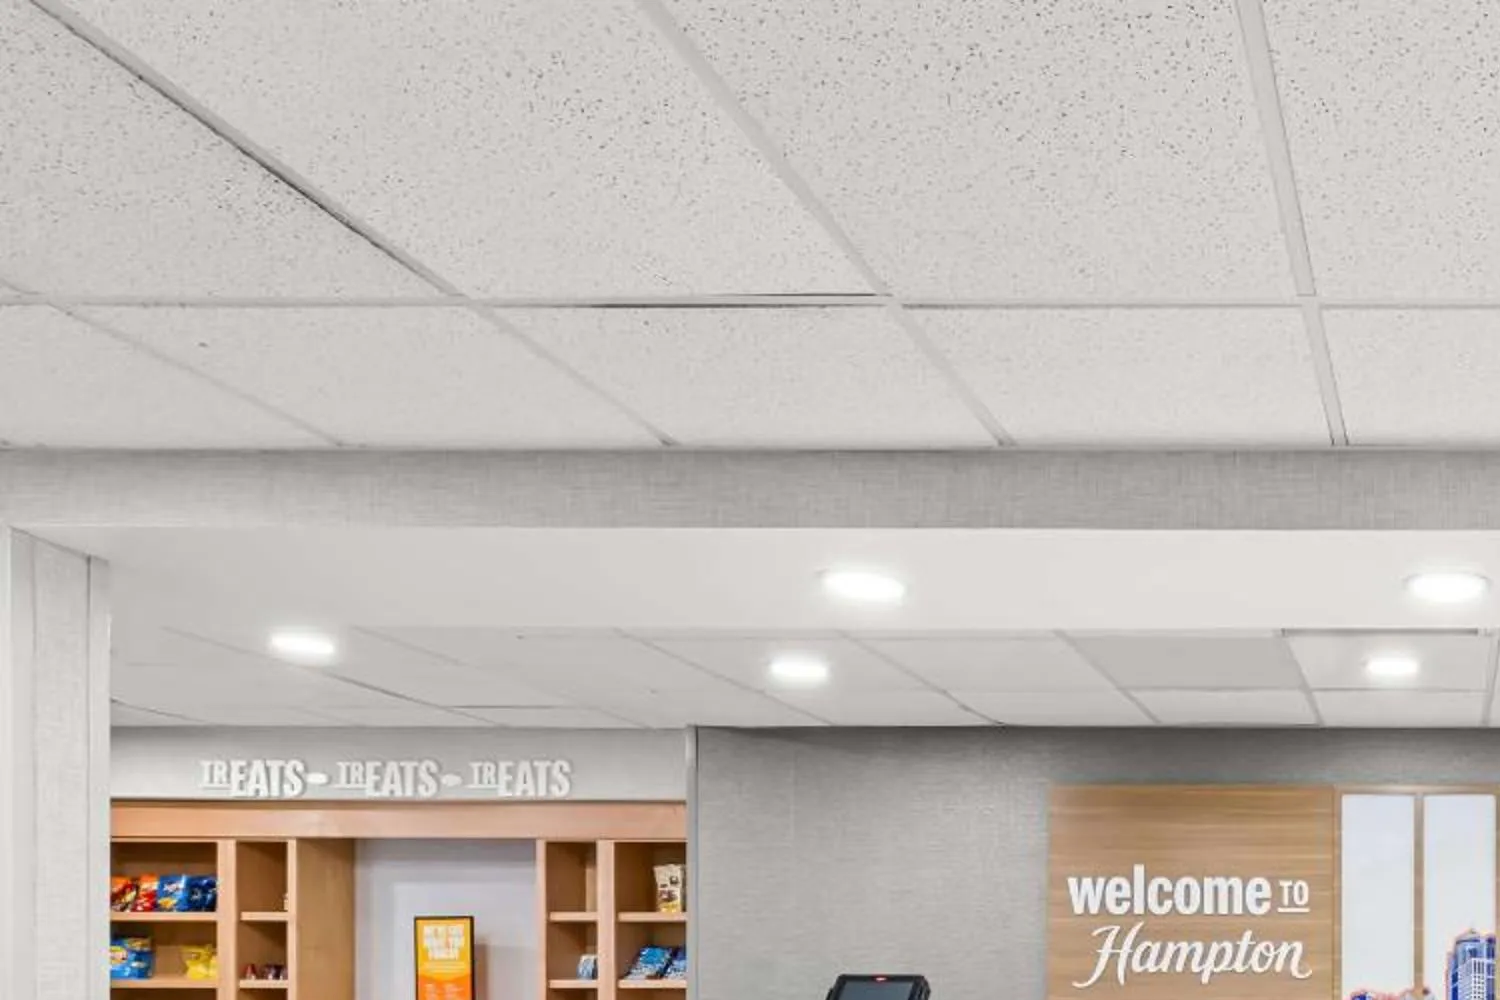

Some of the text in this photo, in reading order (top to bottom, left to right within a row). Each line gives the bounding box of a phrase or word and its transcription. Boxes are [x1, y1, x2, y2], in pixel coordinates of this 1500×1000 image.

[200, 758, 572, 797] TREATS TREATS TREATS
[1067, 863, 1311, 915] welcome TO
[1071, 921, 1313, 988] Hampton
